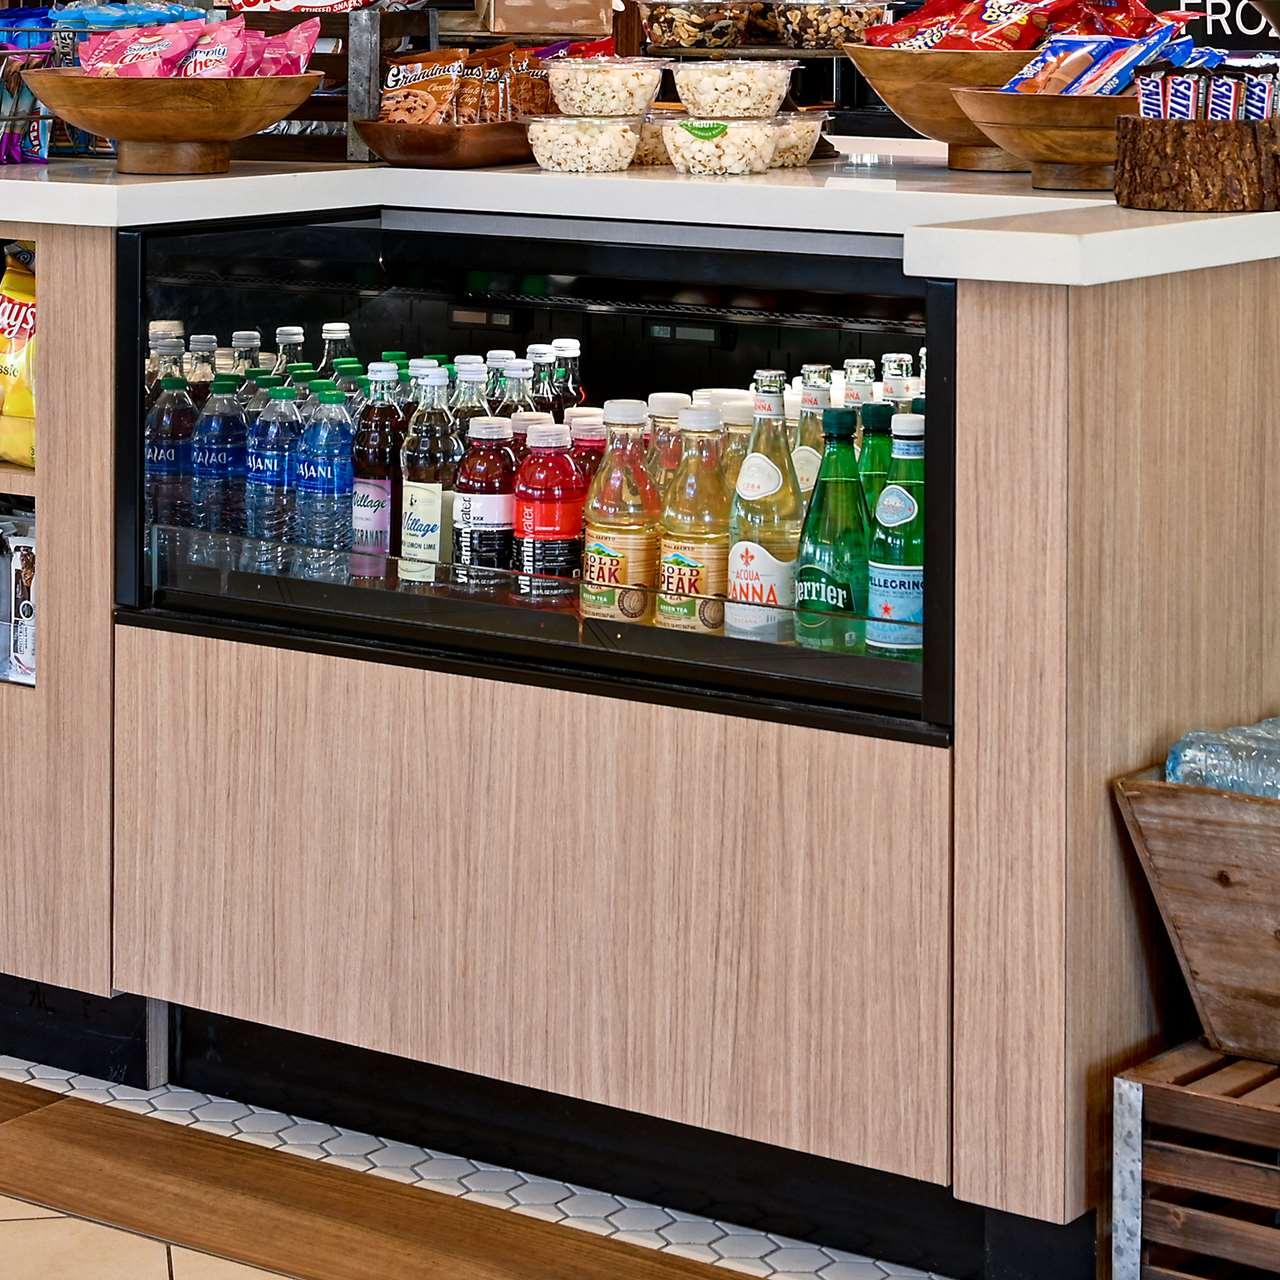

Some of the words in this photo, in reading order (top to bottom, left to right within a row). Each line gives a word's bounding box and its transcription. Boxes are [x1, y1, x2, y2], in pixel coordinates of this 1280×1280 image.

[119, 50, 162, 65] Chex
[182, 57, 225, 77] Chex
[384, 59, 464, 90] Grandma's
[403, 511, 440, 537] Village
[423, 542, 436, 551] LIME
[455, 496, 472, 584] vitaminwater
[519, 505, 535, 594] vitaminwater
[661, 565, 700, 577] GOLD
[735, 570, 761, 582] ACQUA
[661, 574, 700, 594] PEAK
